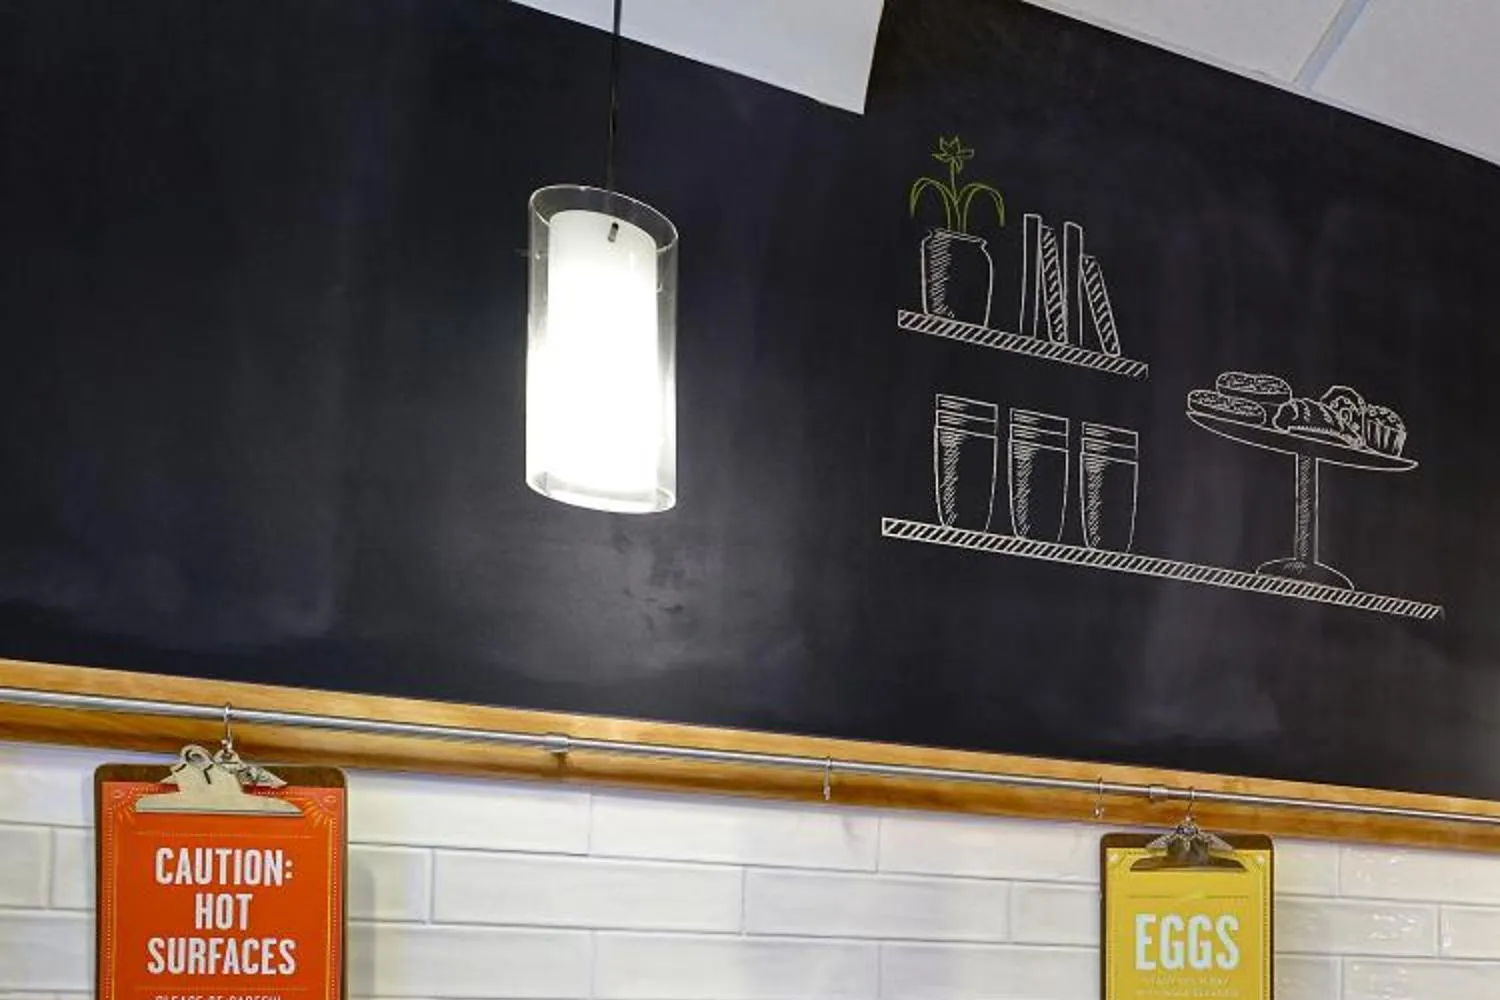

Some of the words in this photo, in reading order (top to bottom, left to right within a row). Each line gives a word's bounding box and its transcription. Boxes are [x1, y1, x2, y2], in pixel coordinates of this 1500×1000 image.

[155, 847, 293, 886] CAUTION:
[195, 893, 253, 930] HOT
[147, 937, 296, 975] SURFACES
[1135, 914, 1240, 971] EGGS
